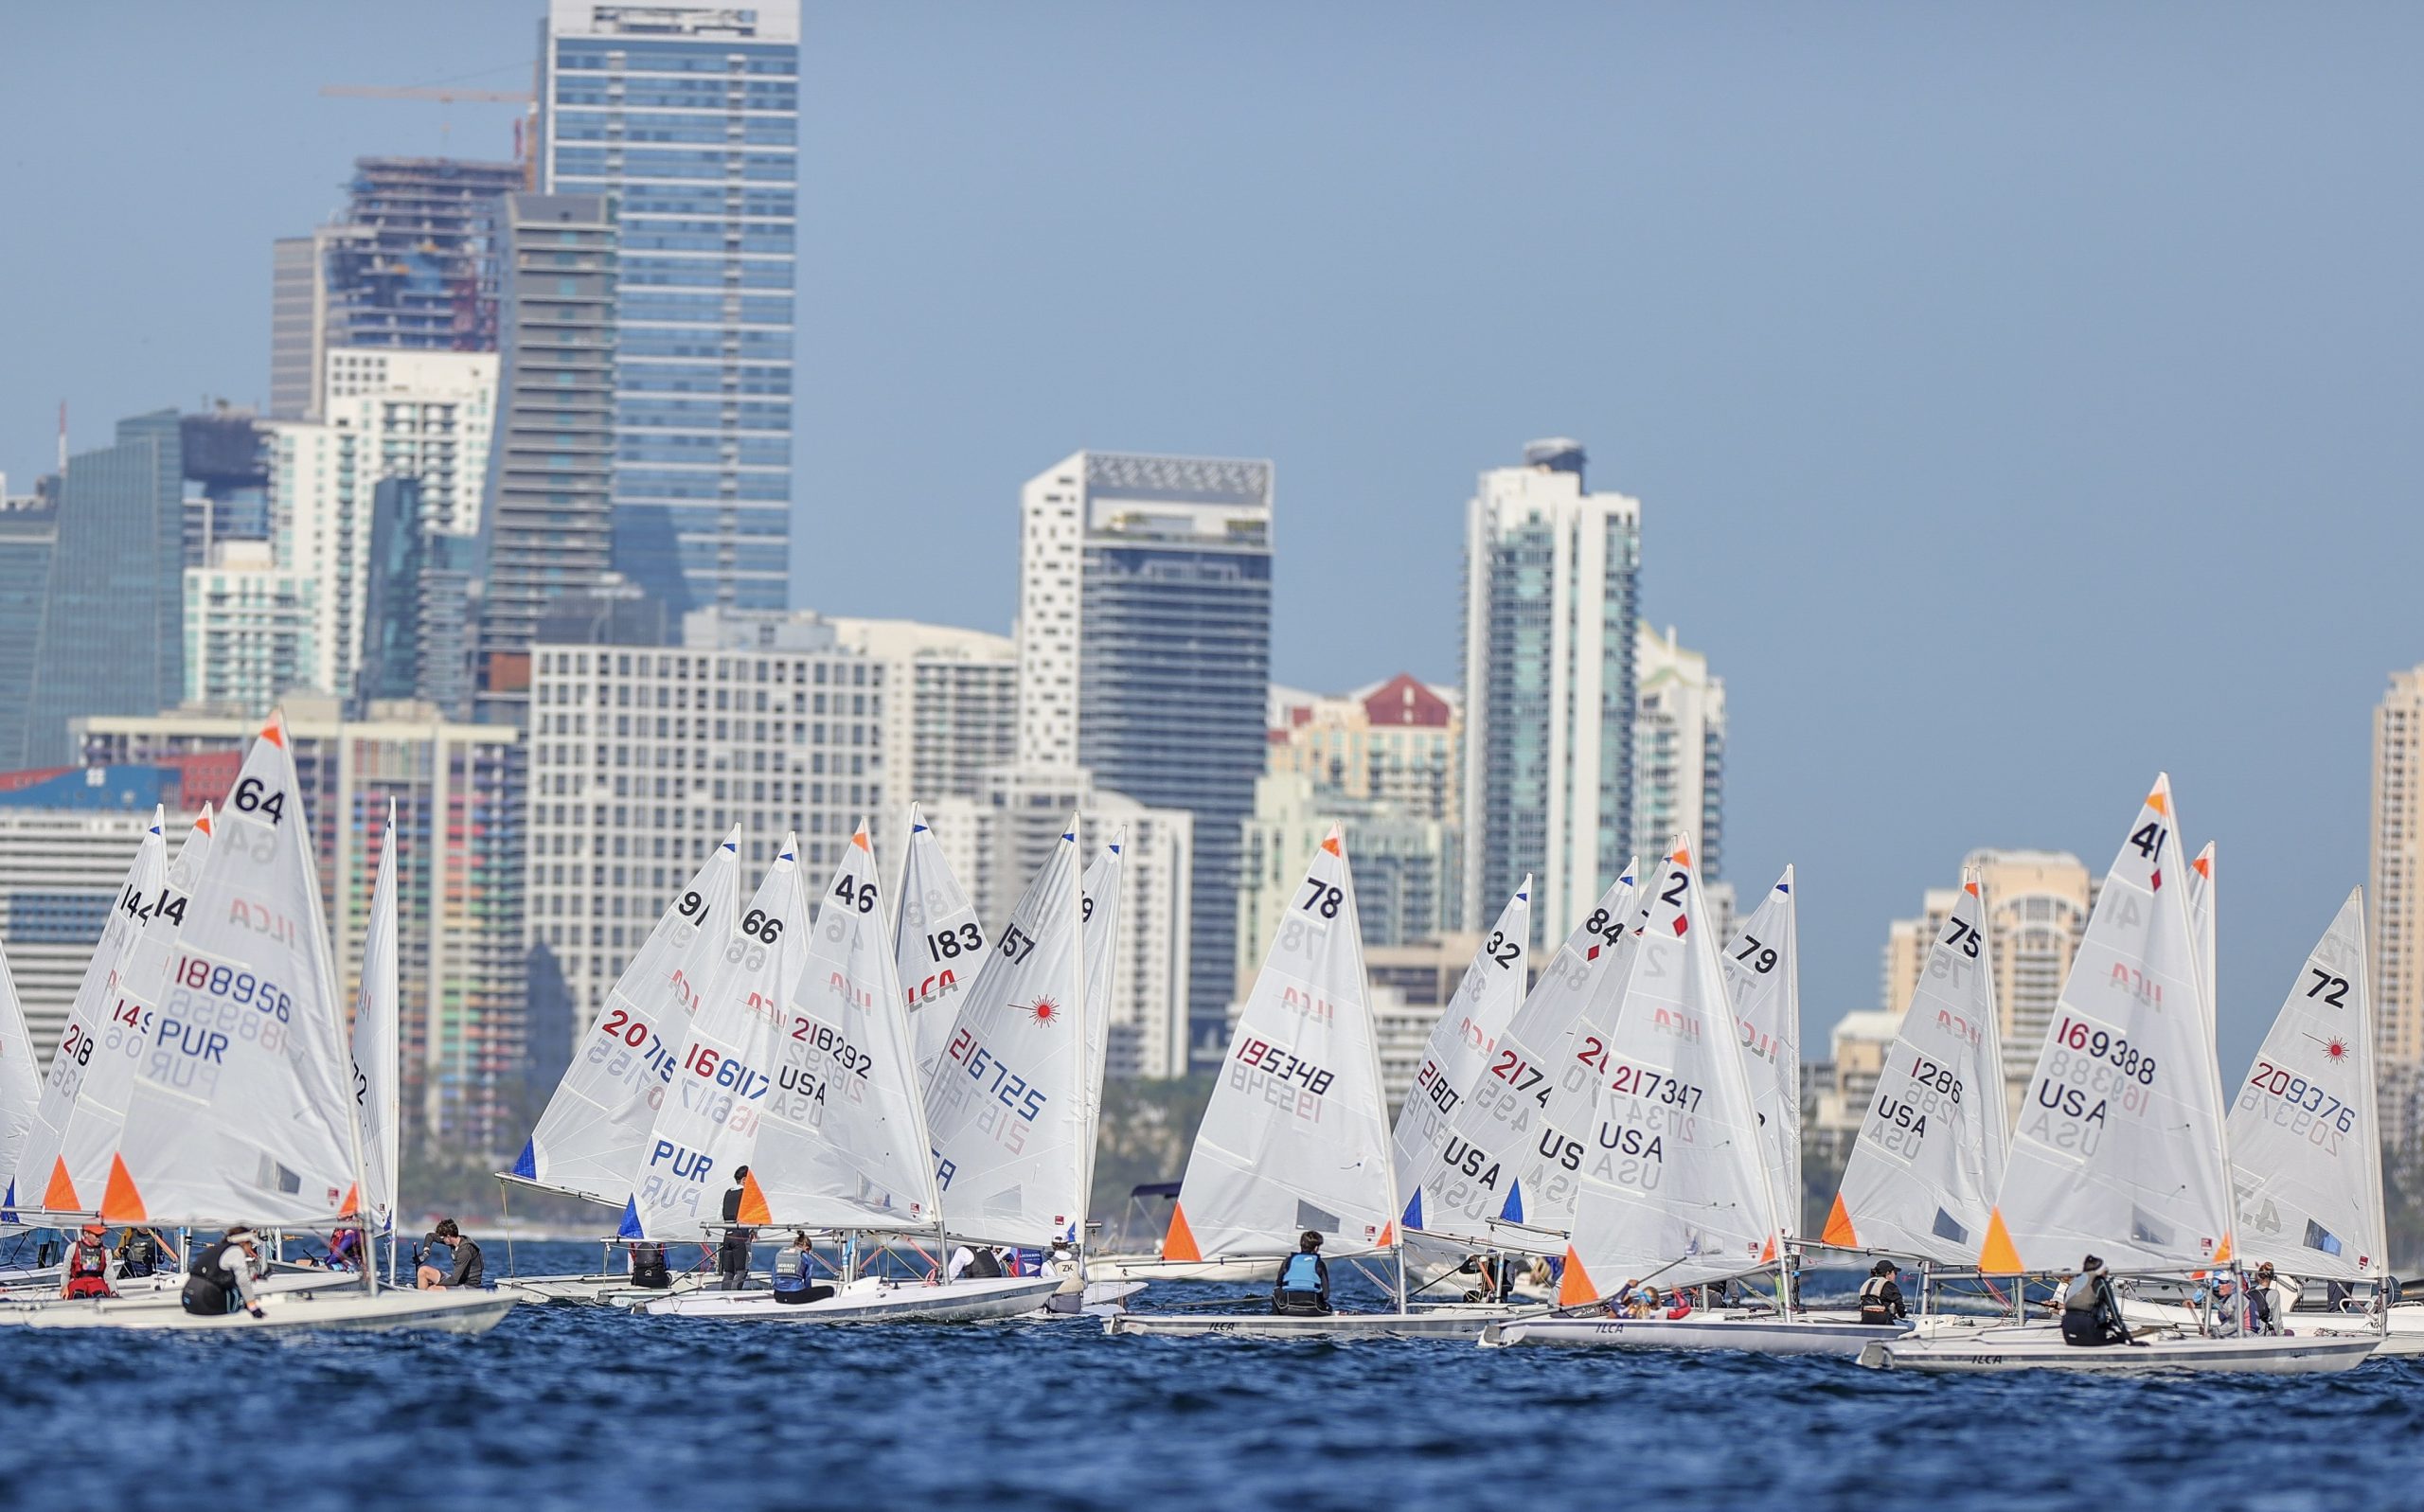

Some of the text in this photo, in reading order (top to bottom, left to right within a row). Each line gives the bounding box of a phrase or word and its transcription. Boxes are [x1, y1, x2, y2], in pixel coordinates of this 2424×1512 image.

[235, 776, 285, 825] 64
[2130, 822, 2168, 863] 41
[678, 891, 710, 926] 91
[835, 874, 878, 914] 46
[1302, 877, 1344, 918] 78
[1661, 871, 1689, 907] 2
[741, 909, 783, 945] 66
[927, 922, 983, 963] 183
[997, 922, 1036, 966] 157
[1586, 908, 1625, 947] 84
[1944, 916, 1982, 958] 75
[1487, 931, 1521, 969] 32
[1736, 934, 1778, 973] 79
[175, 954, 292, 1024] 188956
[902, 969, 959, 1013] LCA
[2307, 968, 2350, 1009] 72
[156, 1019, 229, 1064] PUR
[793, 1017, 873, 1080] 218292
[2057, 1017, 2157, 1086] 169388
[685, 1042, 770, 1100] 166117
[778, 1065, 829, 1106] USA
[949, 1027, 1047, 1122] 216725
[1236, 1037, 1335, 1096] 195348
[1911, 1057, 1964, 1105] 1286
[1613, 1065, 1702, 1113] 217347
[2039, 1077, 2108, 1130] USA
[2250, 1061, 2357, 1134] 209376
[1879, 1094, 1927, 1139] USA
[650, 1139, 713, 1183] PUR
[1443, 1135, 1501, 1191] USA
[1598, 1121, 1664, 1164] USA
[1209, 1322, 1236, 1331] ILCA
[1595, 1324, 1624, 1334] ILCA
[1971, 1355, 2003, 1364] ILCA
